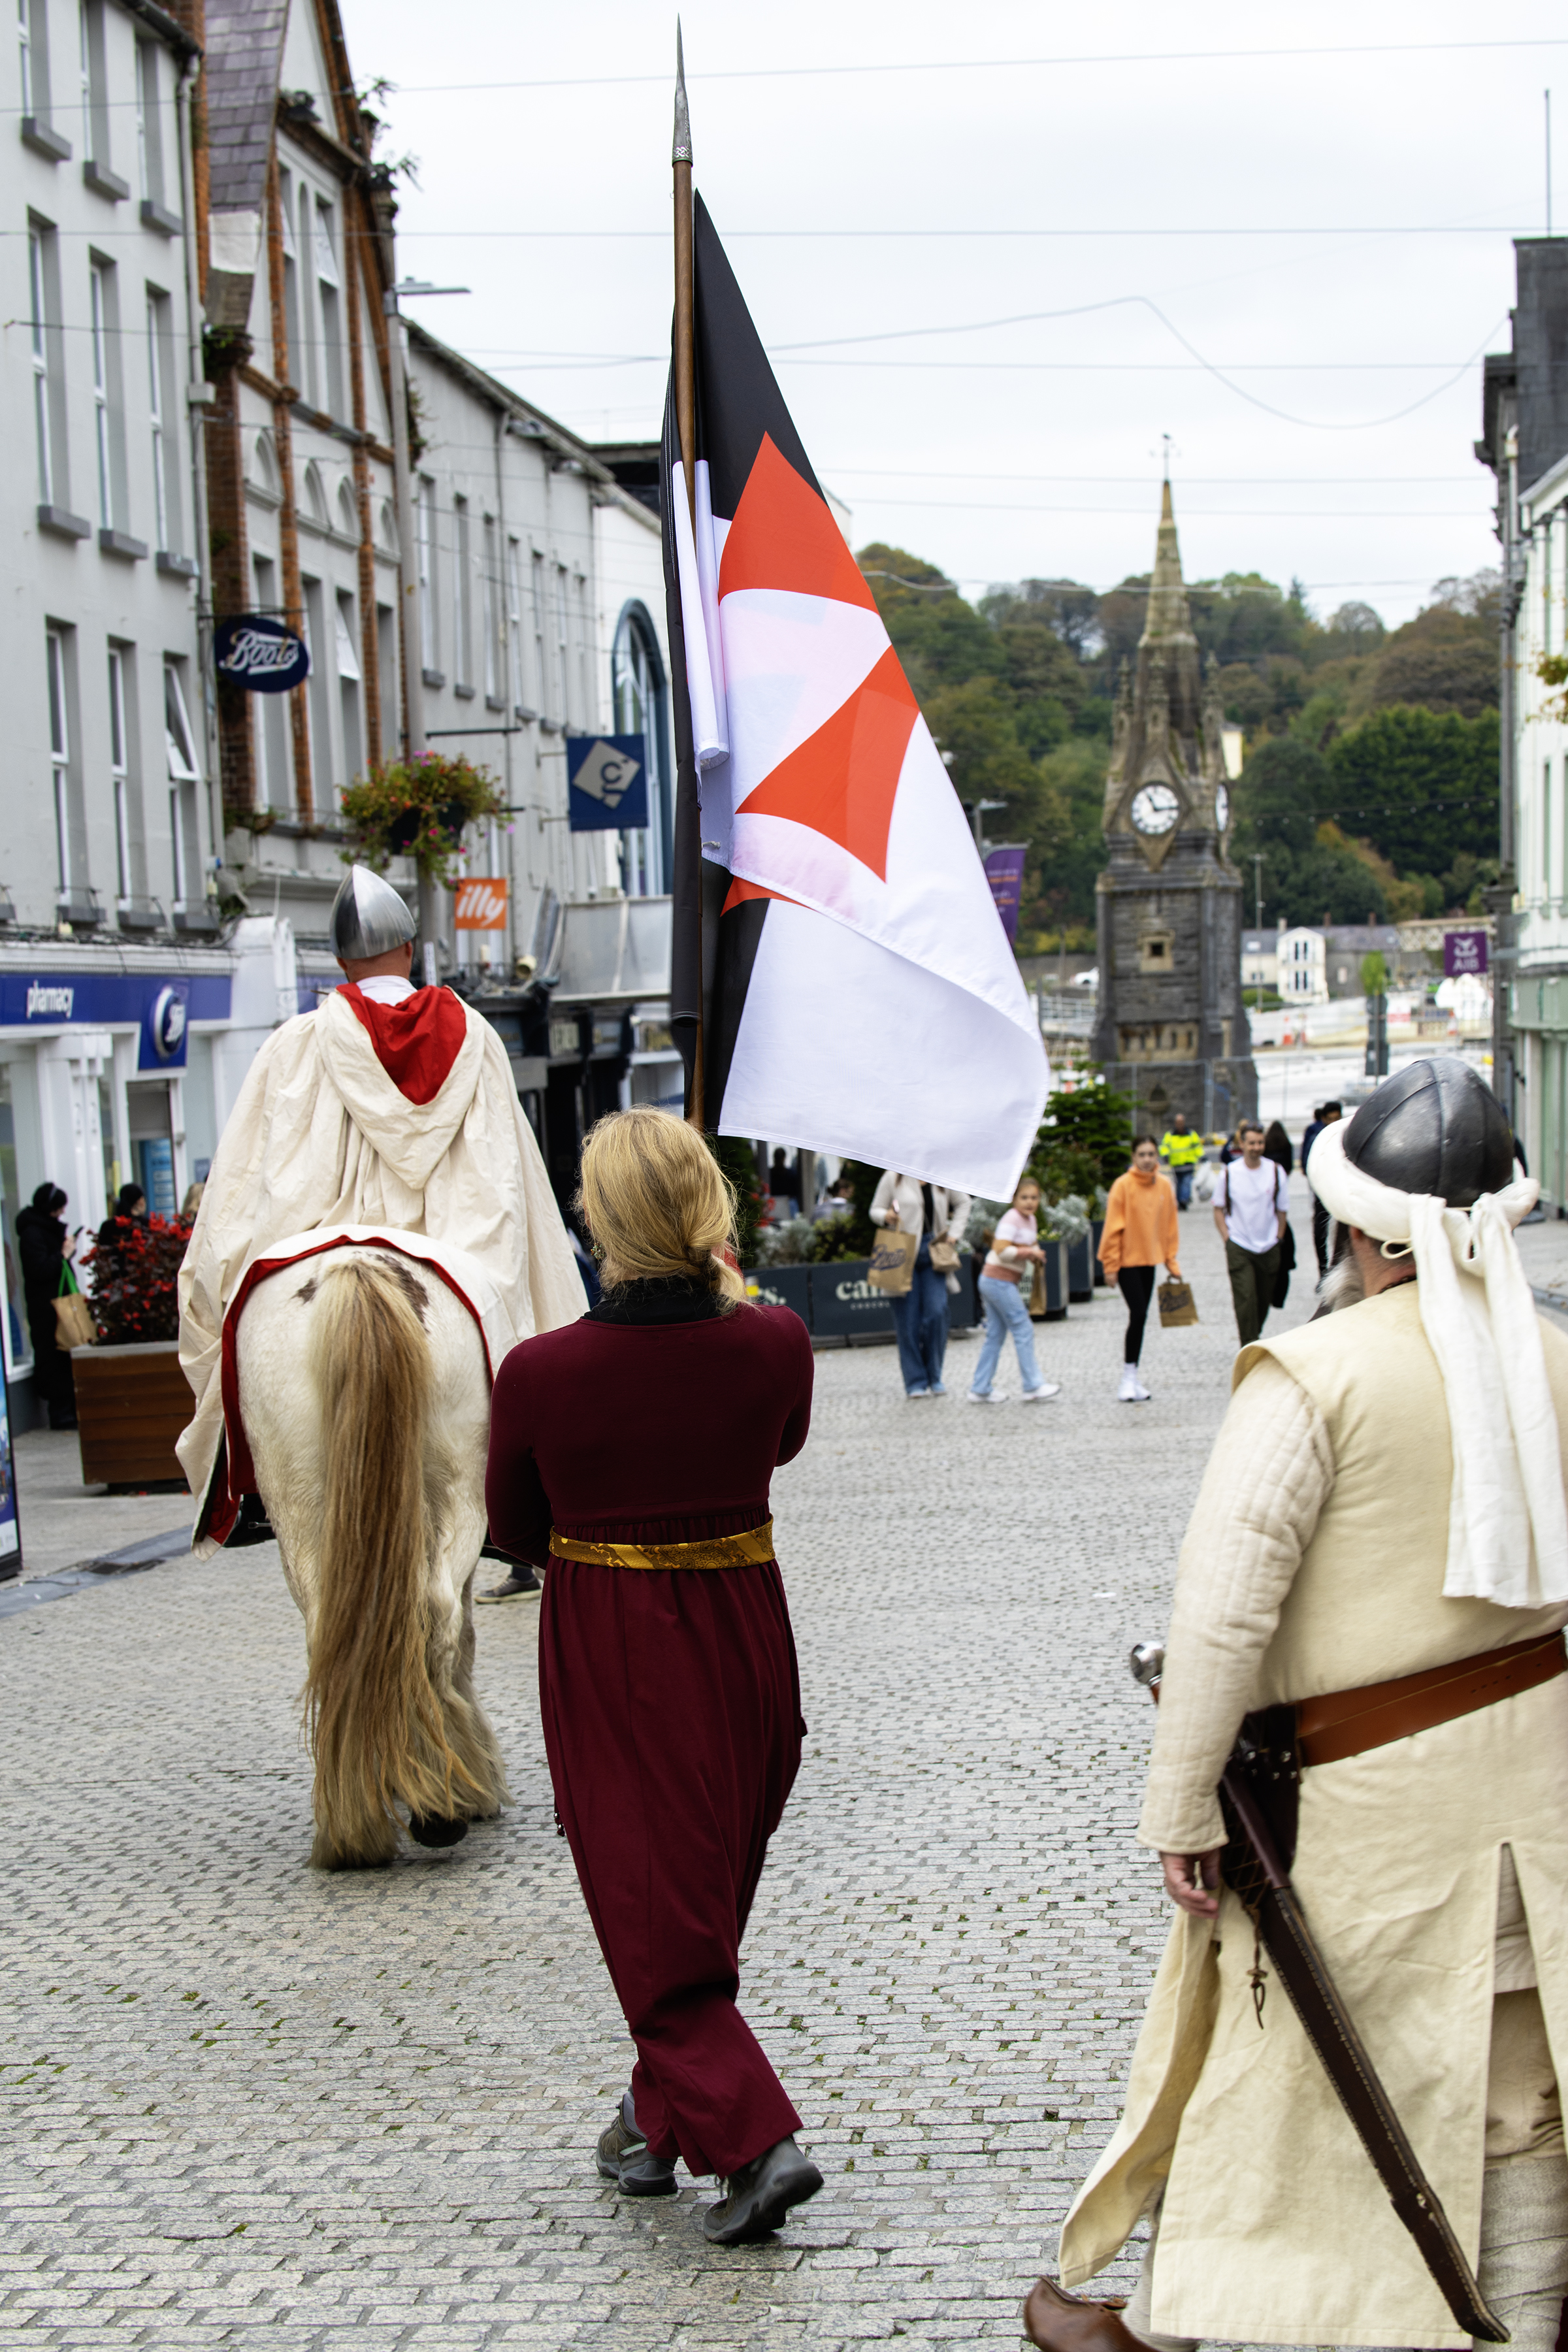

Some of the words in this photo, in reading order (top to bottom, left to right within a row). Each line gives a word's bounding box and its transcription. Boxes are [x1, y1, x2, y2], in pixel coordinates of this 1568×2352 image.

[218, 627, 300, 676] Boots
[457, 883, 505, 927] illy
[1452, 956, 1480, 973] AIB
[26, 979, 74, 1020] pharmacy
